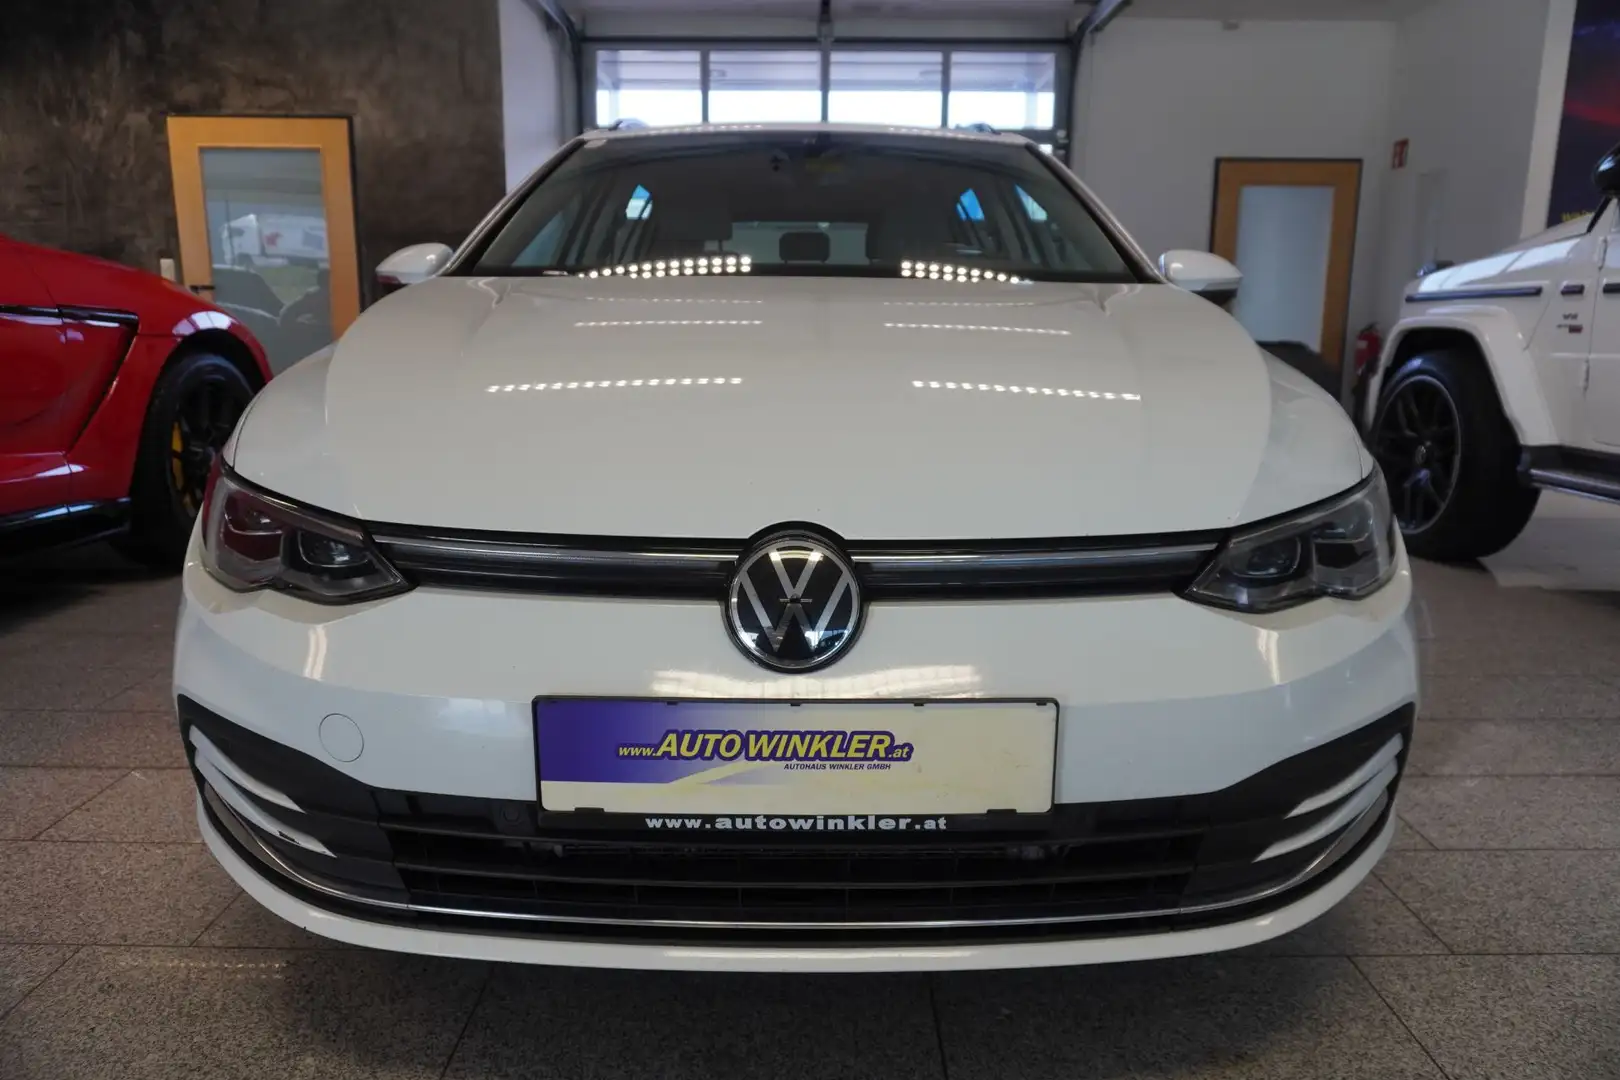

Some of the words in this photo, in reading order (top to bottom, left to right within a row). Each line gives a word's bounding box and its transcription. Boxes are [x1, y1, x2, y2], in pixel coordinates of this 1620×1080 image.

[783, 763, 827, 771] AUTOHAUS
[828, 763, 865, 771] WINKLER
[866, 763, 892, 771] GMBH
[645, 814, 948, 831] www.autowinkler.at
